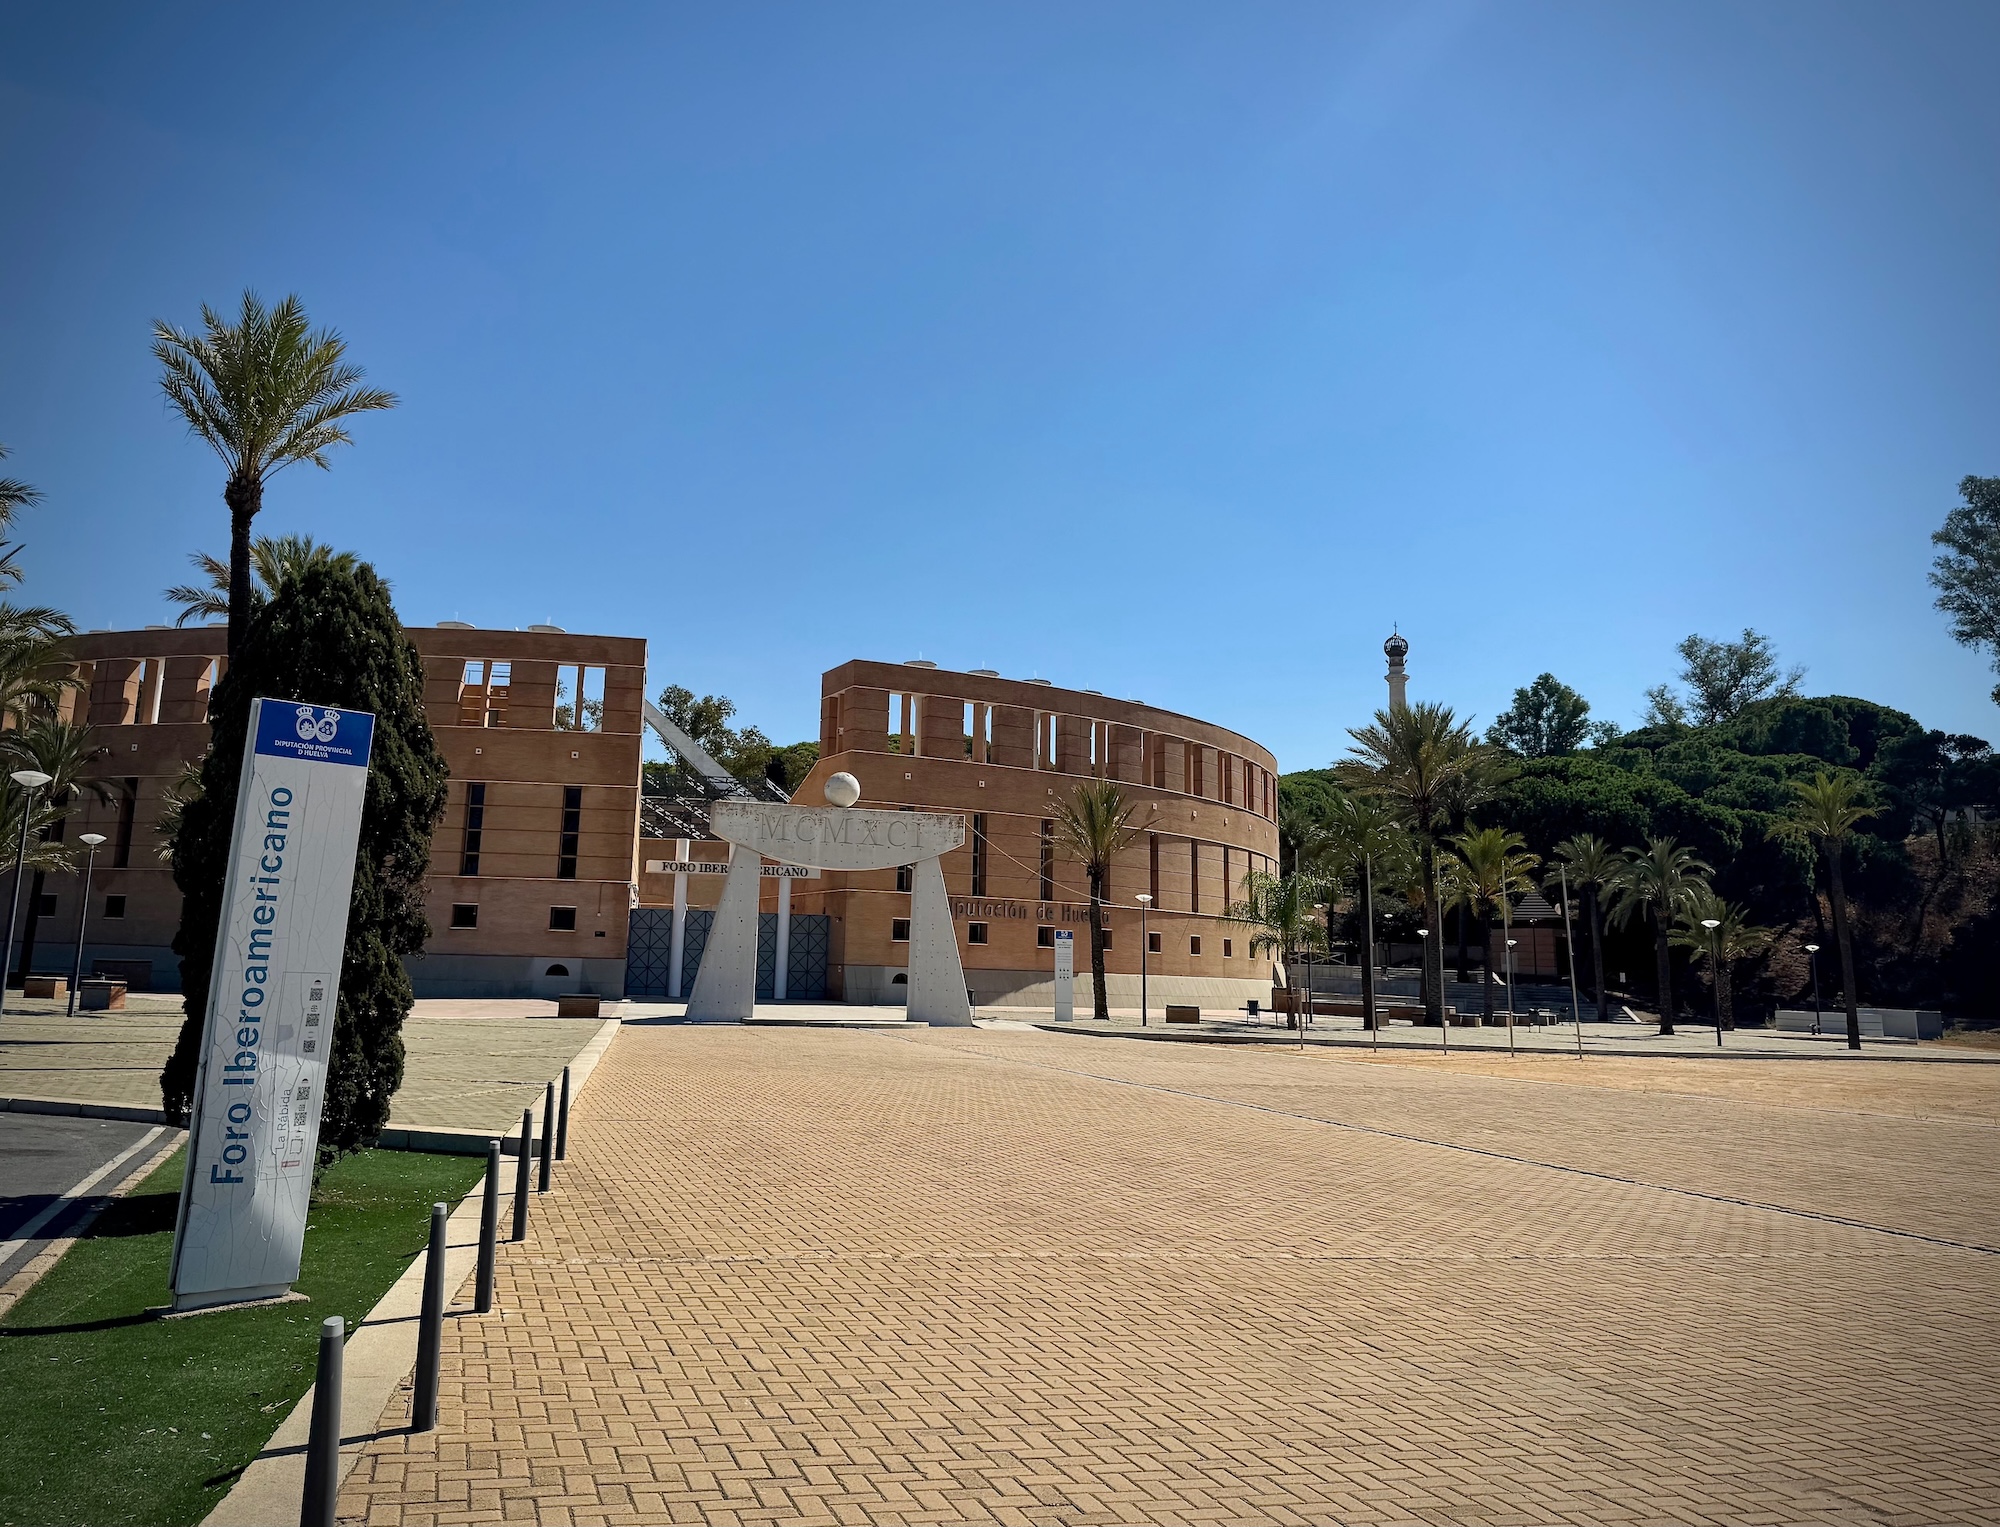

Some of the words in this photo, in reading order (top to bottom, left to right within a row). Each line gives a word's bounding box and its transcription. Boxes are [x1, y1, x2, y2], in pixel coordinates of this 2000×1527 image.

[274, 739, 314, 750] DIPUTACIÓN
[314, 744, 352, 755] PROVINCIAL
[303, 750, 328, 758] HUELVA
[757, 812, 925, 848] MCMXCI
[662, 861, 696, 872] FORO
[1036, 902, 1054, 920] de
[1061, 903, 1110, 924] Huea
[222, 787, 293, 1085] Iberoamericano
[276, 1089, 291, 1131] Rábida
[210, 1103, 252, 1184] Foro
[275, 1136, 286, 1150] La
